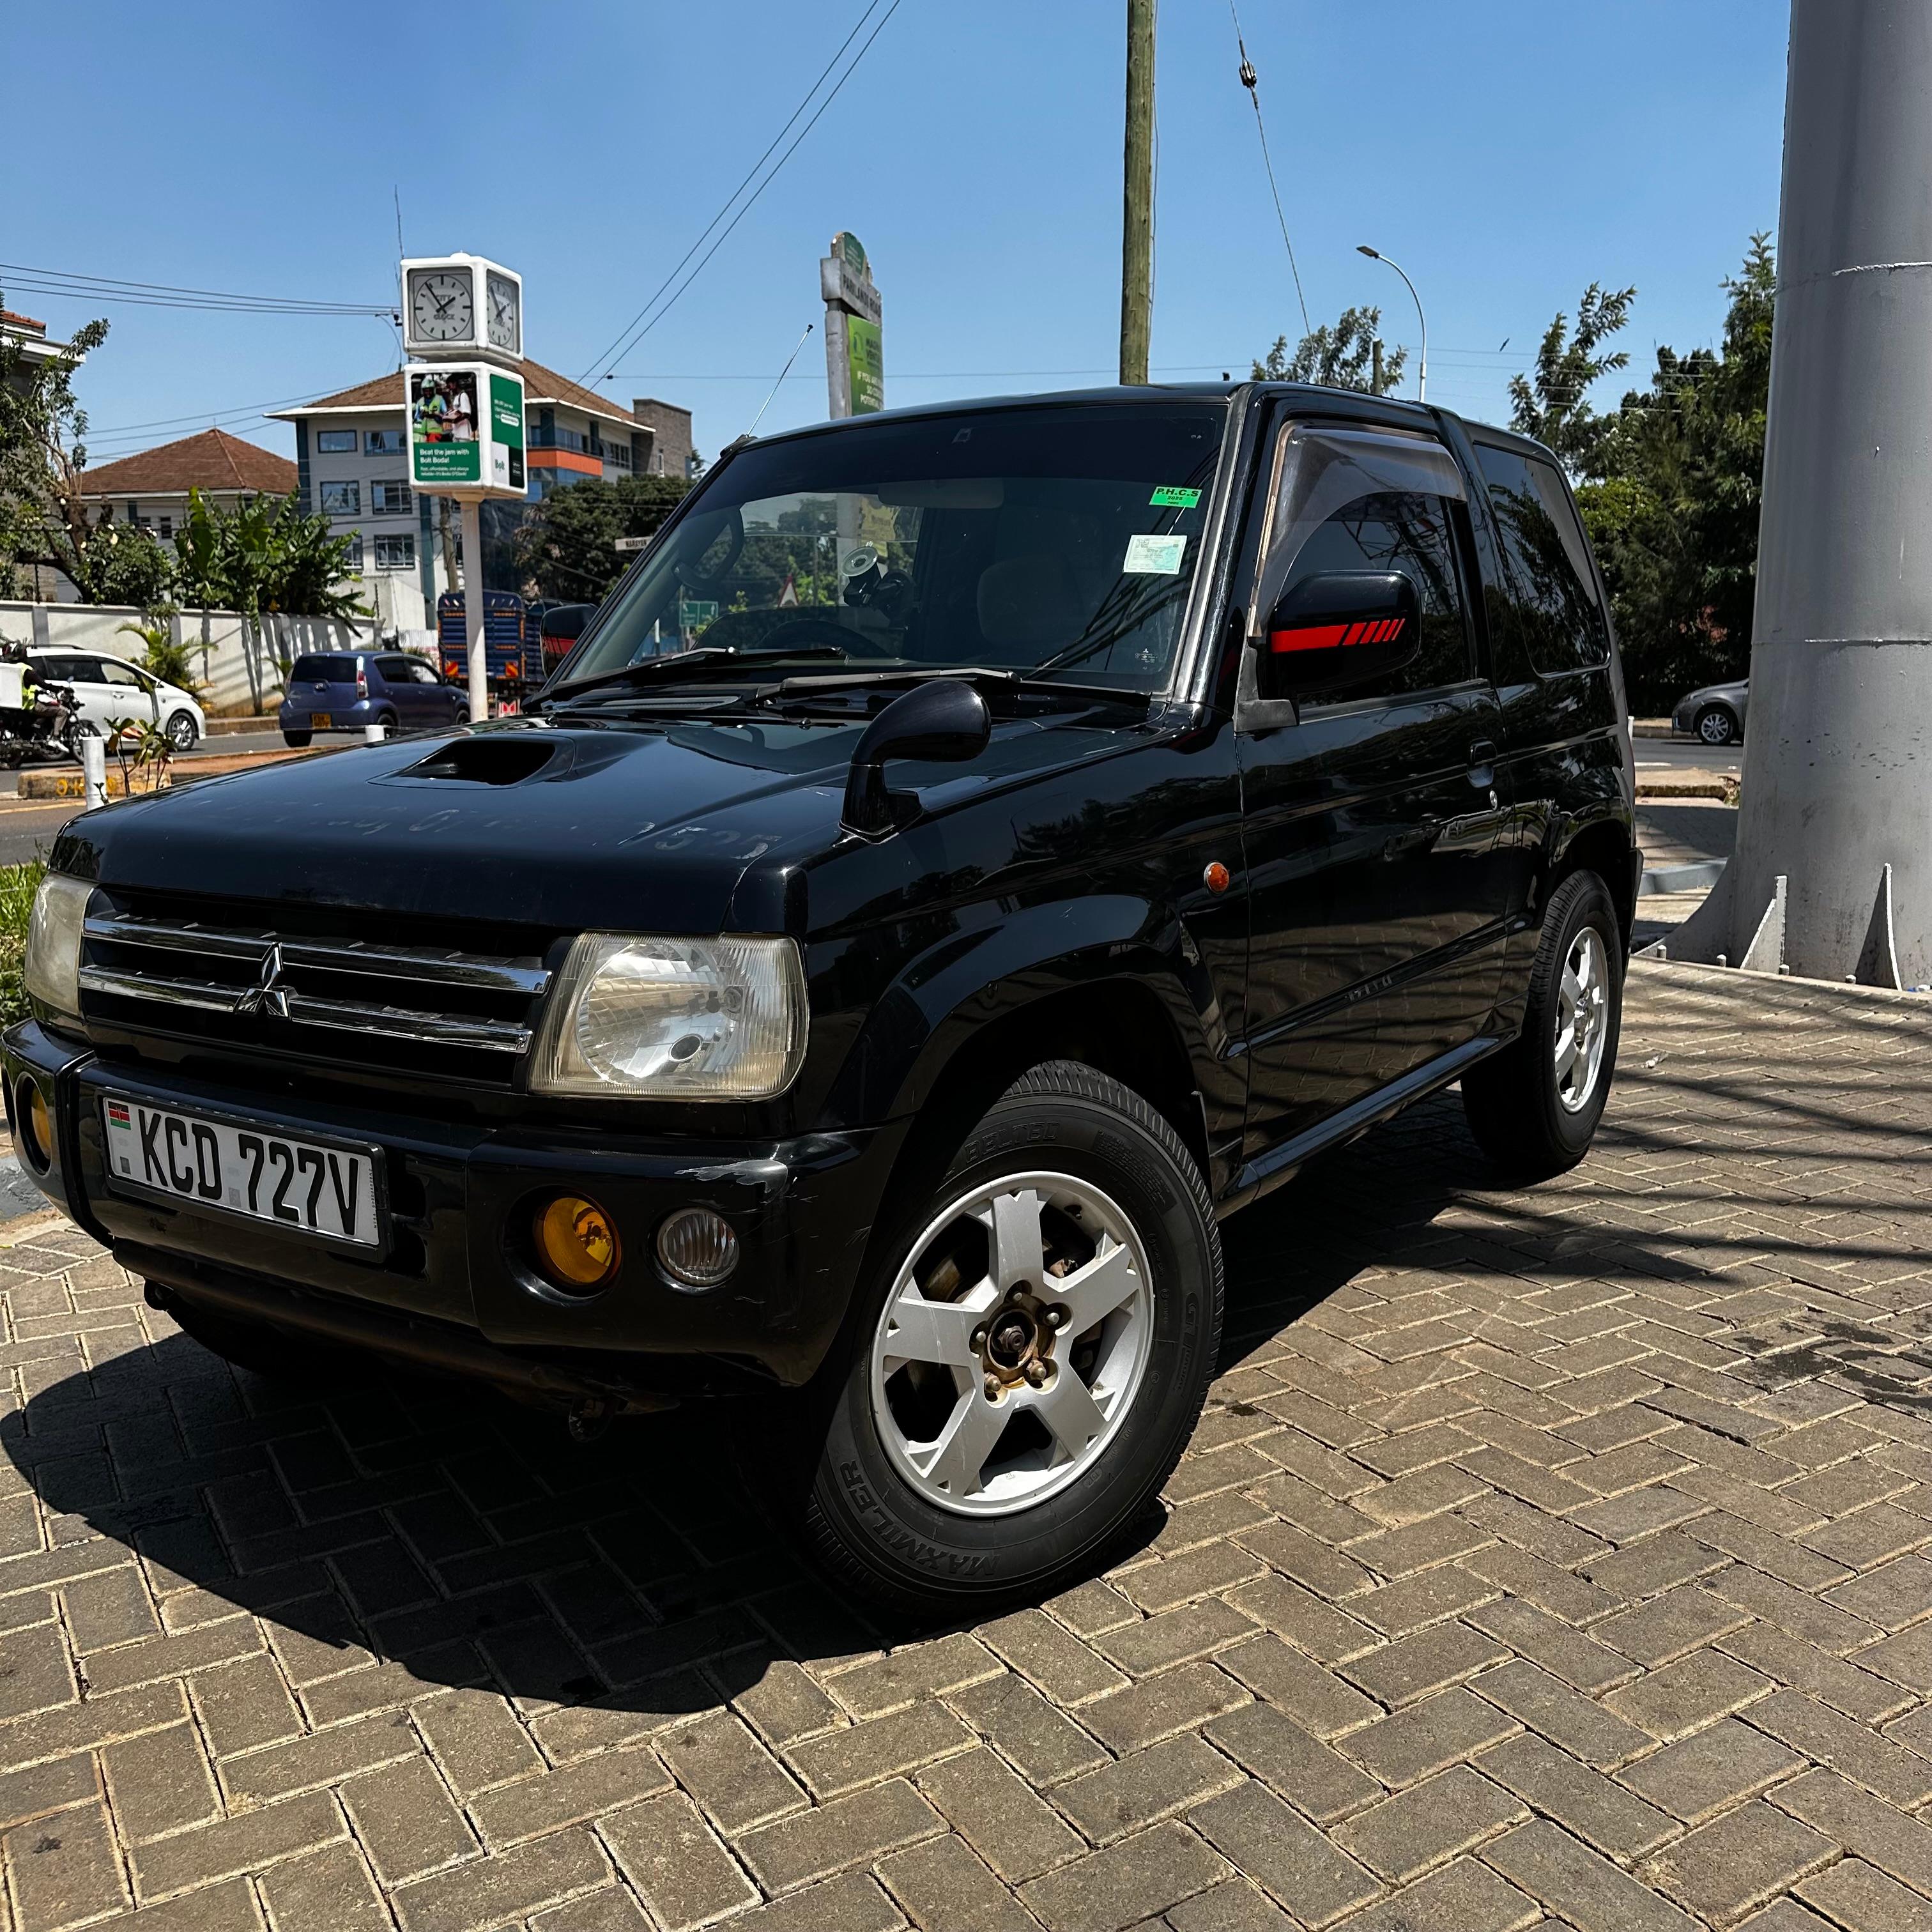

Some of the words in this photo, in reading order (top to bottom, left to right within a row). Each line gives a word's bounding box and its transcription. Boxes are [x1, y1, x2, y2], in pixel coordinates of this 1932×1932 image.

[445, 448, 456, 457] jam
[494, 459, 505, 471] Bolt
[1156, 487, 1199, 497] P.H.C.S
[964, 1121, 1061, 1165] BELTED
[137, 1108, 222, 1200] KCD
[238, 1133, 359, 1236] 727V
[839, 1459, 1002, 1576] MAXMILER
